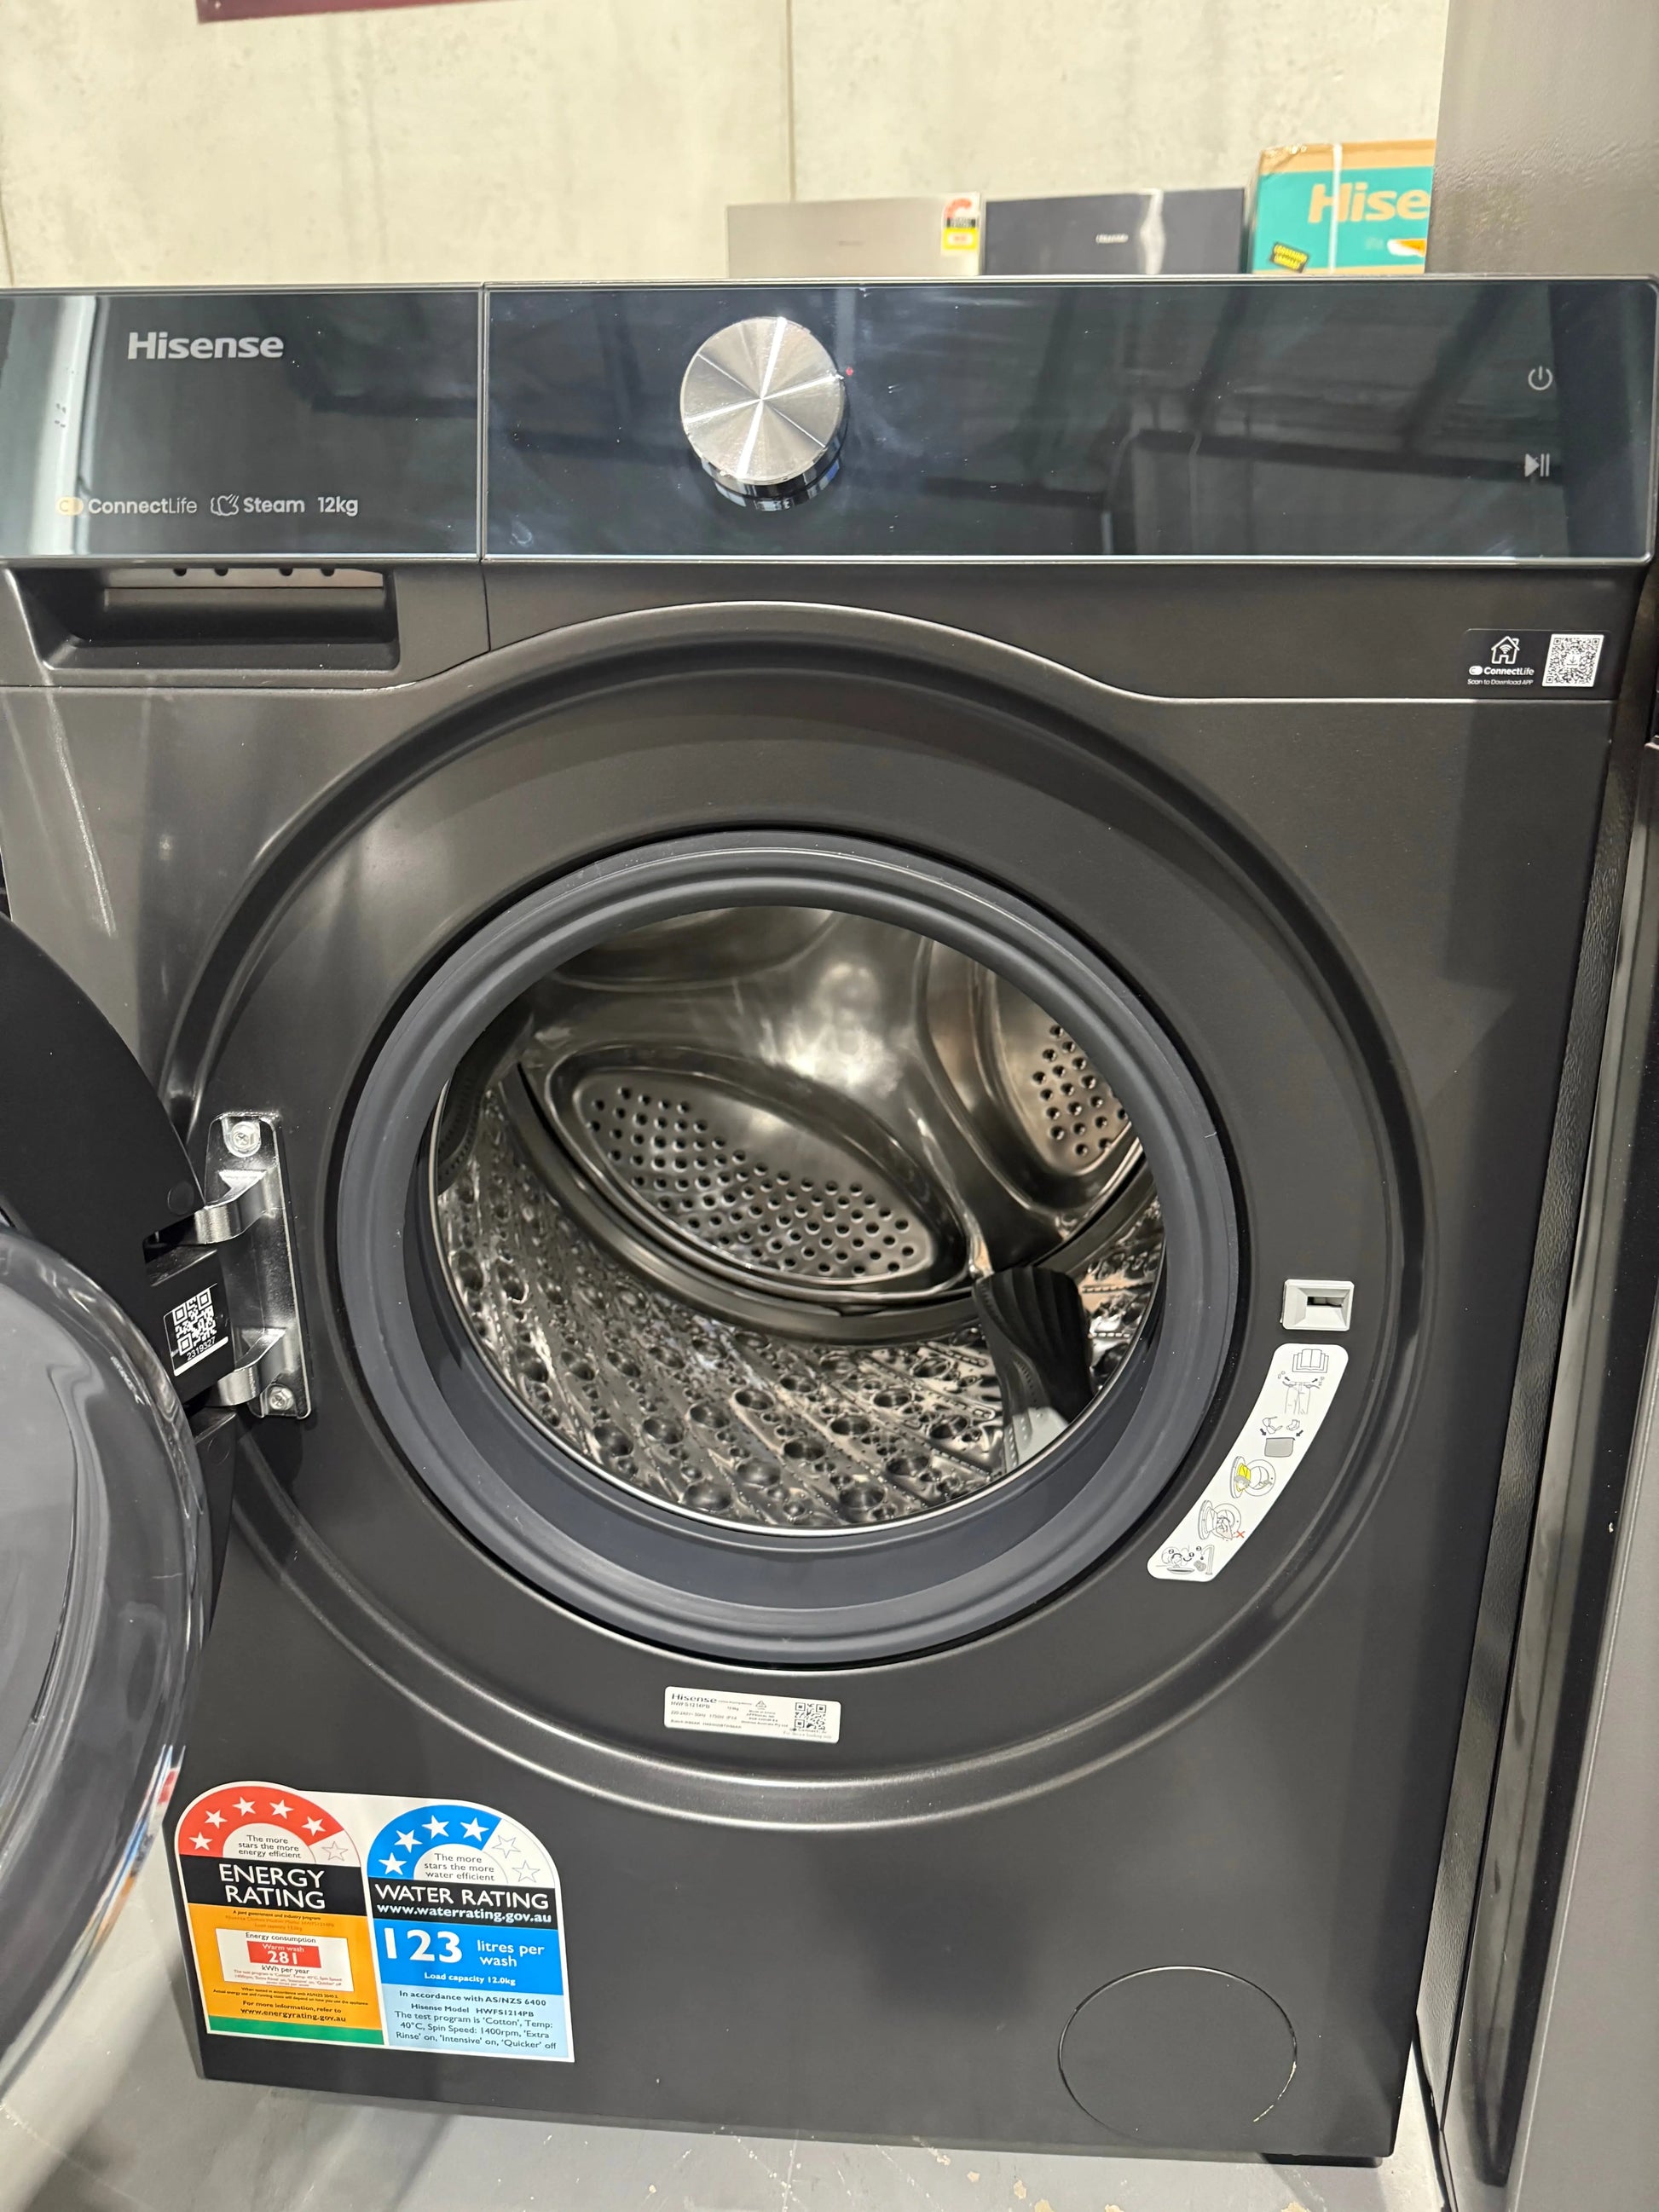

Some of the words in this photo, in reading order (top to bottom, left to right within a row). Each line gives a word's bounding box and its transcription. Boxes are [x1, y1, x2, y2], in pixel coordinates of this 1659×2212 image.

[1307, 182, 1431, 223] Hise
[127, 332, 284, 360] Hisense
[88, 497, 198, 514] ConnectLife
[243, 497, 305, 513] Steam
[317, 496, 358, 517] 12kg
[1483, 666, 1535, 676] ConnectLife
[187, 1336, 216, 1361] 2319327
[672, 1693, 717, 1703] Hisense
[434, 1852, 454, 1862] The
[424, 1862, 448, 1870] stars
[218, 1863, 325, 1889] ENERGY
[456, 1872, 495, 1881] efficient
[225, 1885, 326, 1909] RATING
[374, 1883, 454, 1904] WATER
[461, 1888, 549, 1910] RATING
[377, 1903, 552, 1924] www.waterrating.gov.au
[246, 1932, 269, 1941] Energy
[271, 1935, 316, 1943] consumption
[384, 1927, 463, 1964] 123
[477, 1939, 514, 1954] litres
[518, 1944, 545, 1958] per
[267, 1950, 298, 1965] 281
[479, 1955, 517, 1967] wash
[424, 1972, 447, 1980] Load
[448, 1974, 485, 1984] capacity
[487, 1975, 516, 1986] 12.0kg
[410, 1992, 462, 2001] accordance
[485, 1995, 522, 2005] AS/NZS
[240, 2007, 346, 2023] www.energyrating.gov.au
[275, 2003, 315, 2012] information,
[411, 2002, 442, 2012] Hisense
[444, 2005, 470, 2013] Model
[476, 2007, 535, 2018] HWFS1214PB
[434, 2014, 471, 2024] program
[524, 2019, 553, 2029] Temp:
[427, 2024, 446, 2033] Spin
[448, 2025, 477, 2036] Speed:
[484, 2038, 500, 2047] on,
[545, 2042, 557, 2050] off
